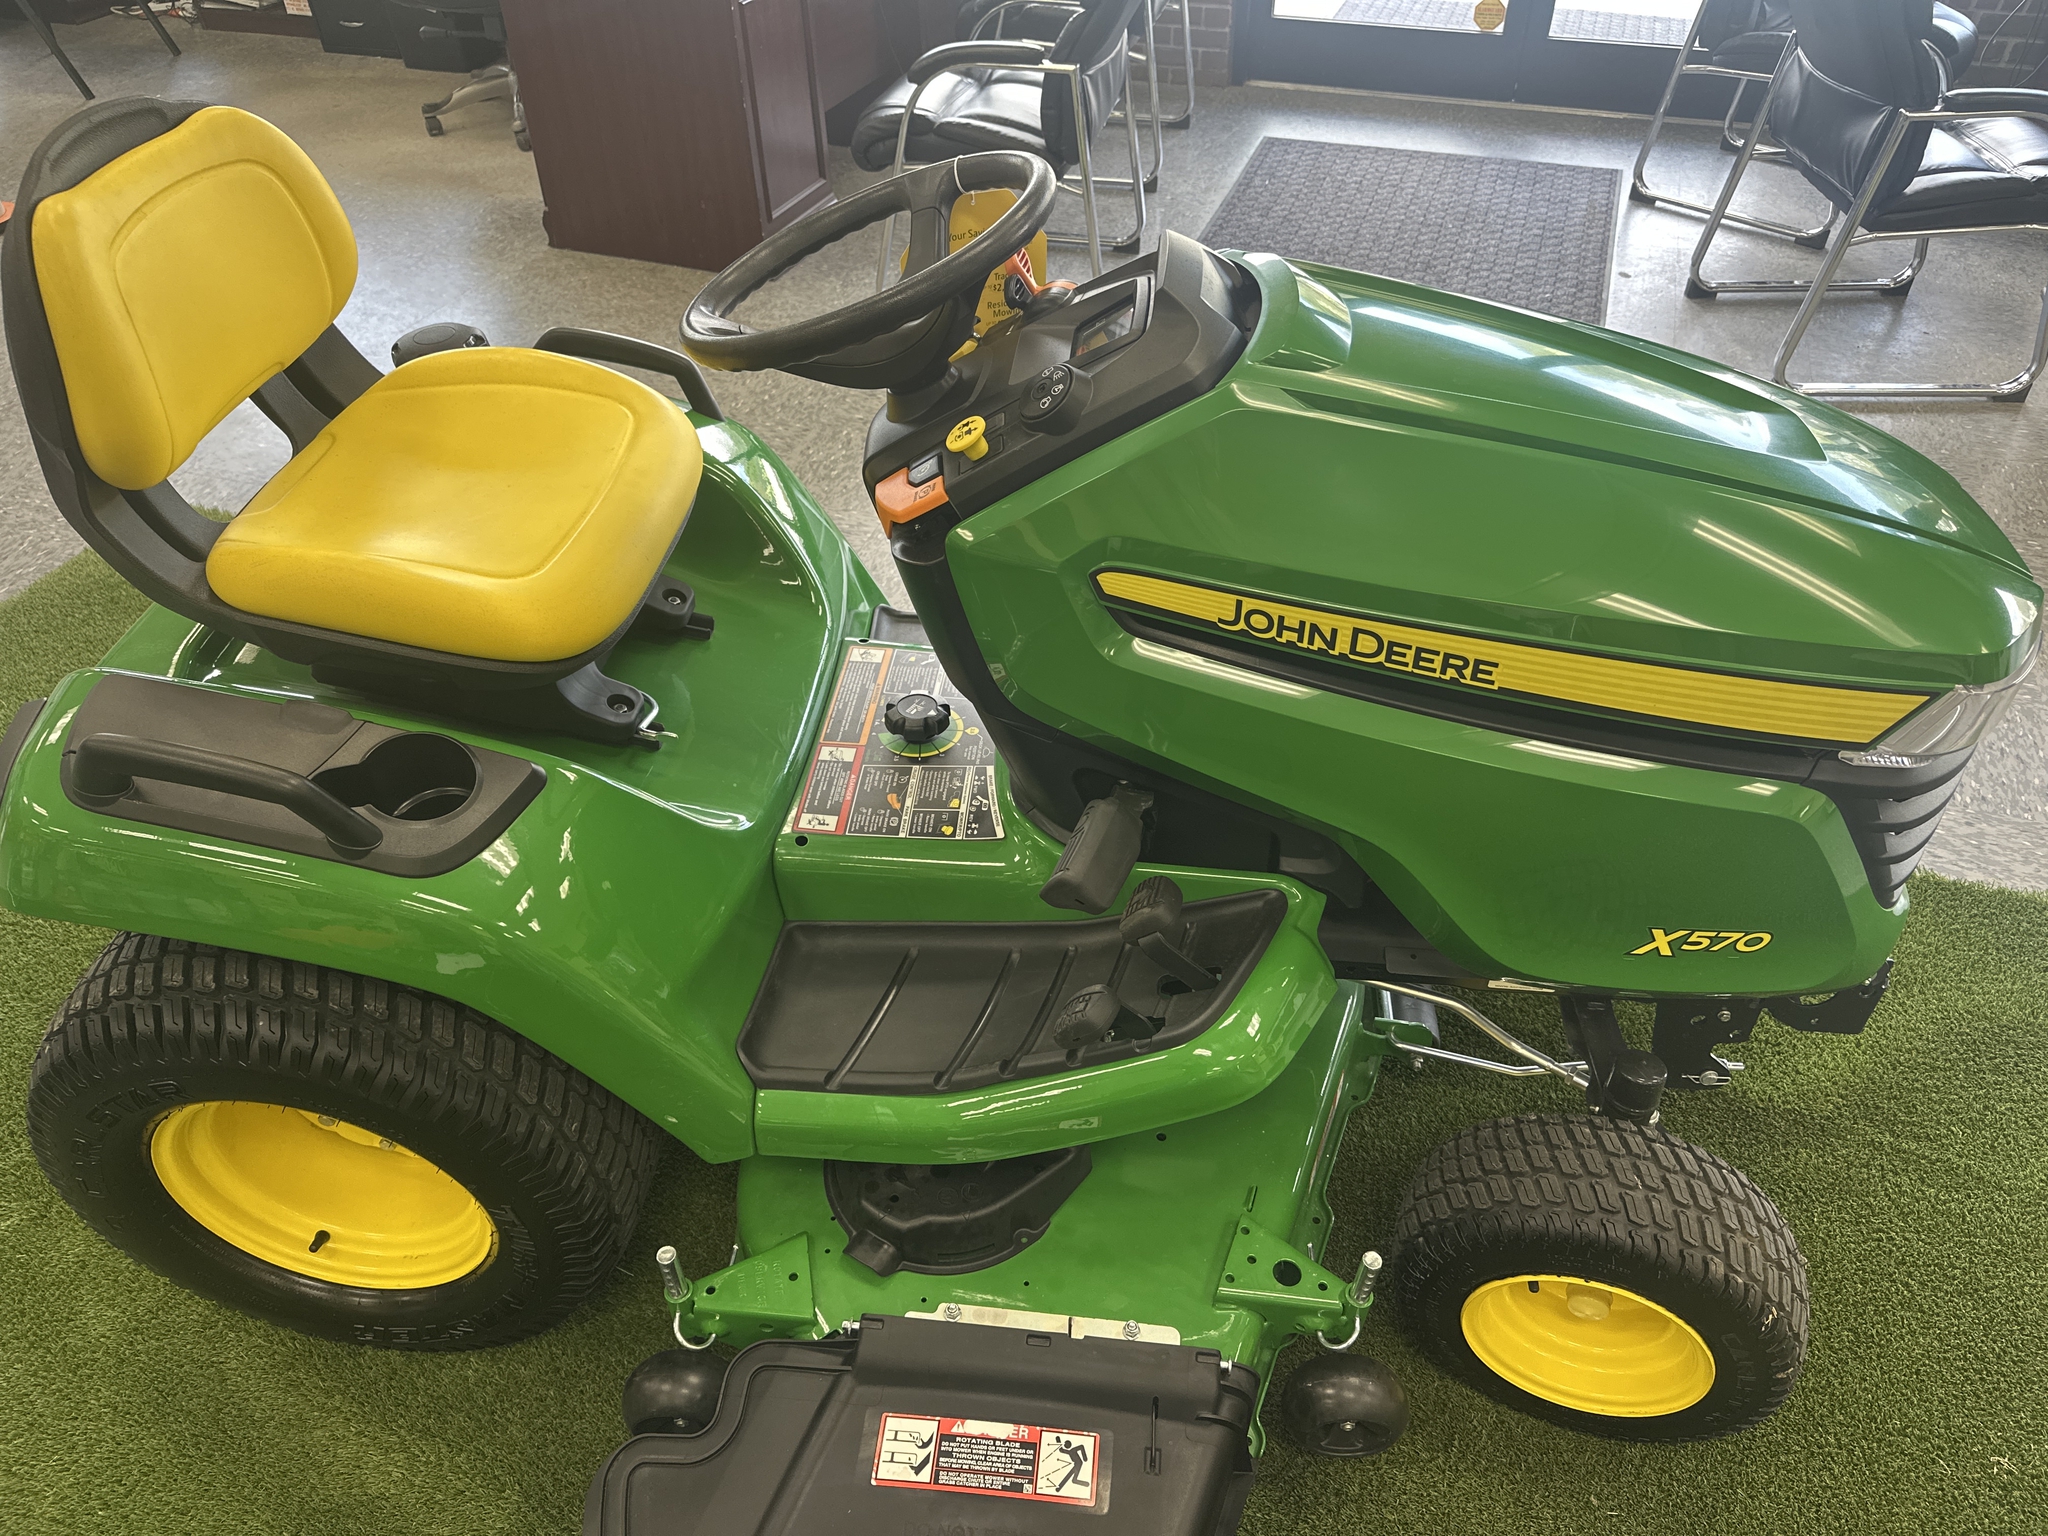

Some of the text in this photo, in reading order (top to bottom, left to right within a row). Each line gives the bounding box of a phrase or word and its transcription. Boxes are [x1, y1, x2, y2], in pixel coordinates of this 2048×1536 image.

[1218, 599, 1500, 688] JOHN DEERE
[846, 779, 856, 800] DANGER
[1626, 928, 1773, 957] X570
[956, 1437, 1020, 1448] ROTATING BLADE
[952, 1453, 985, 1461] THROWN
